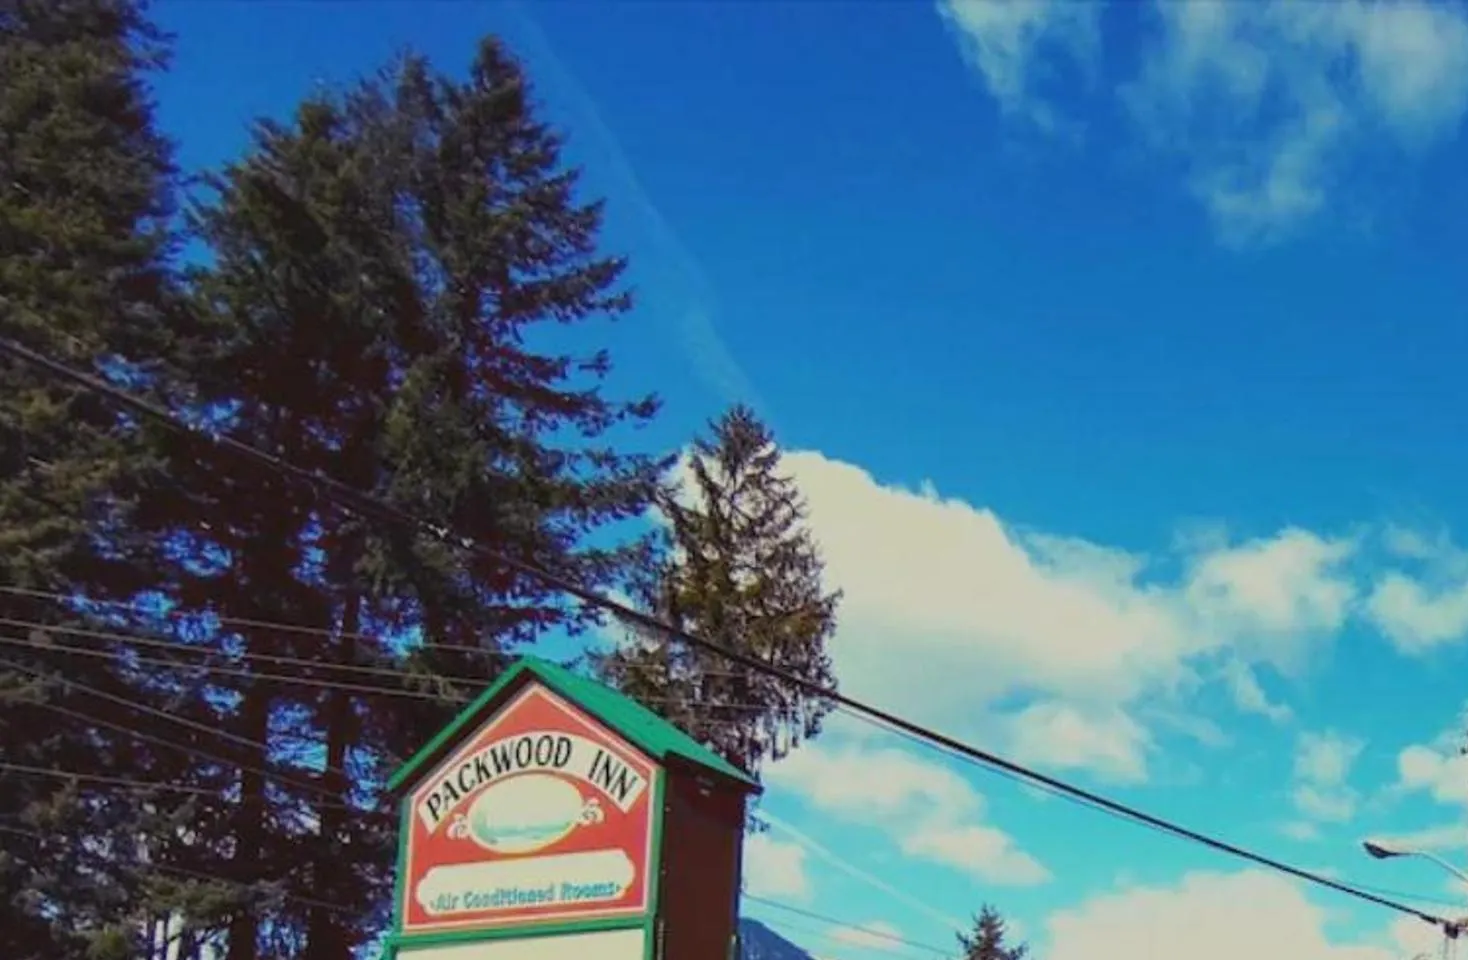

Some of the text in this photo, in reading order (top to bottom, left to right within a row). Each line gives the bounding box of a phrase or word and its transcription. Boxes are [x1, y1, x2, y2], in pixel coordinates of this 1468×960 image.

[426, 735, 638, 822] PACKWOOD INN
[435, 893, 459, 911] Air
[463, 883, 555, 909] Conditioned
